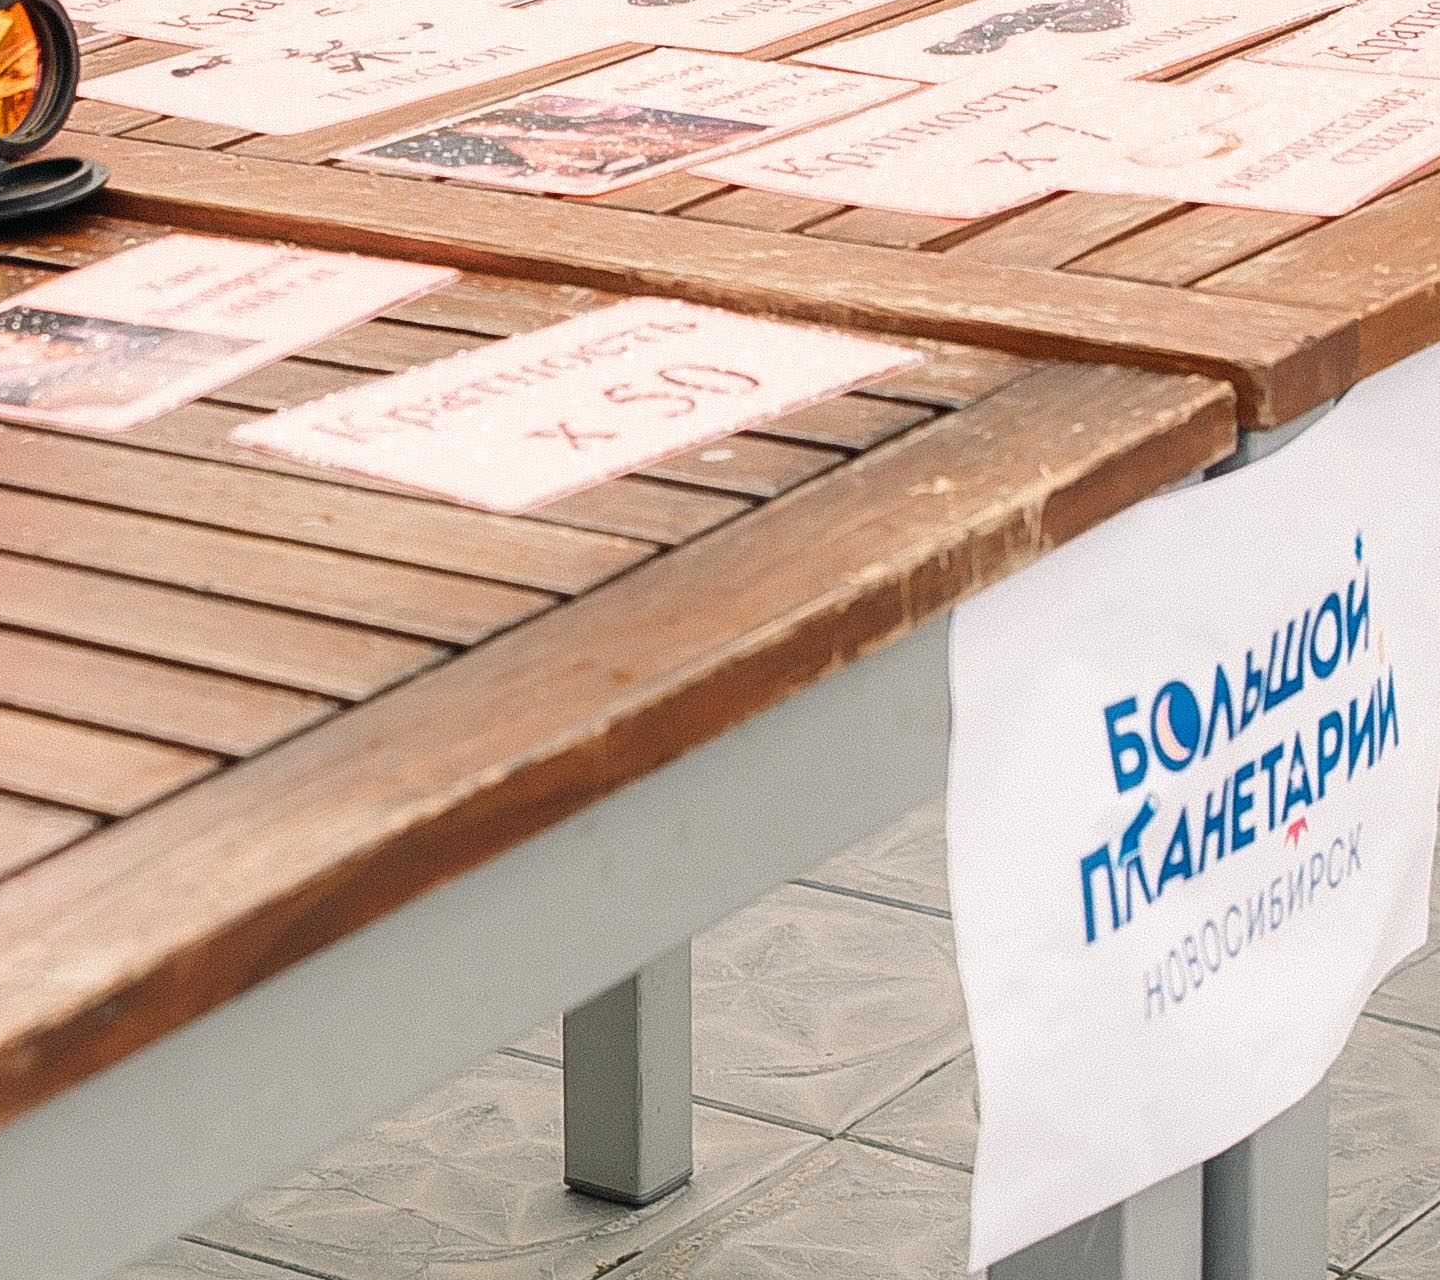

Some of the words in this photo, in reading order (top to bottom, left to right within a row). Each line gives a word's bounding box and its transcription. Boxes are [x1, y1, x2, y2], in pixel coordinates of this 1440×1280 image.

[317, 44, 528, 101] ТЕЛЕСКОП
[759, 82, 1059, 180] Кратность
[310, 322, 697, 444] Кратность
[603, 364, 760, 418] 50
[1104, 542, 1371, 795] БОЛЬШОЙ
[1143, 824, 1365, 1019] НОВОСИБИРСК
